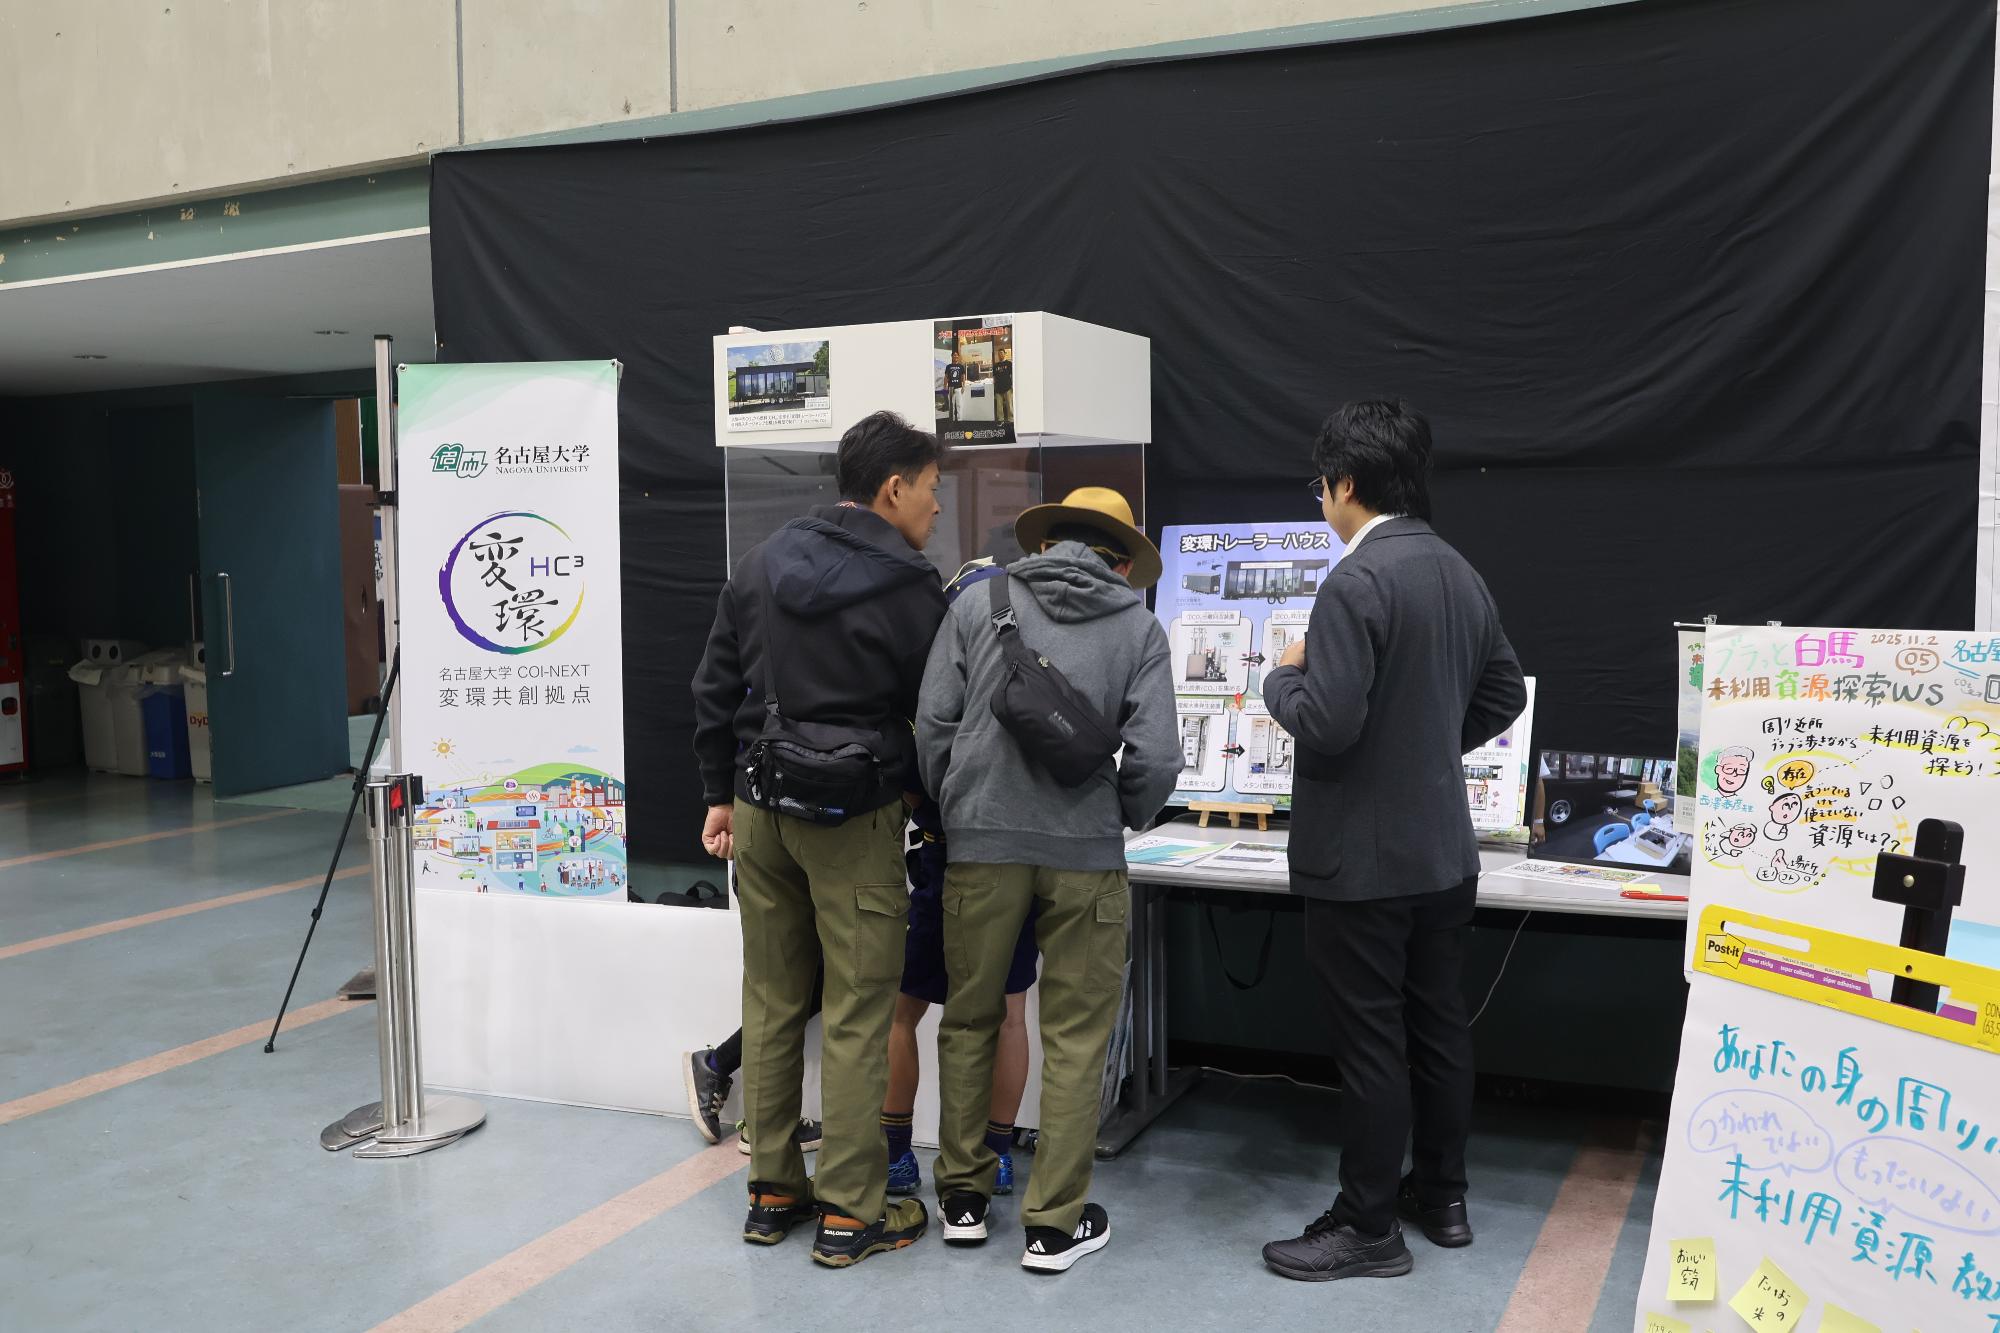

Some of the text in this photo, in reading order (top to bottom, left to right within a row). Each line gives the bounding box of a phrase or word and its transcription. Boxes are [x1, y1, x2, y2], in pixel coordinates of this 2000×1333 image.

[495, 445, 590, 465] 名古屋大学
[495, 464, 589, 474] NAGOYA UNIVERSITY
[1180, 531, 1330, 553] 変環トレーラーハウス
[1870, 632, 1939, 646] 2025.11.2
[439, 664, 590, 682] 名古屋大学 COI-NEXT
[439, 684, 591, 708] 変環共創拠点
[190, 715, 209, 727] DyD
[1762, 717, 1824, 736] 周り近所
[1867, 724, 1972, 756] 未利用資源を
[1804, 806, 1864, 823] 使えていない
[1707, 939, 1740, 958] Post-it
[1760, 959, 1774, 969] sticky
[1713, 1024, 1999, 1153] あなたの身の周り
[823, 1229, 854, 1237] SALOMON
